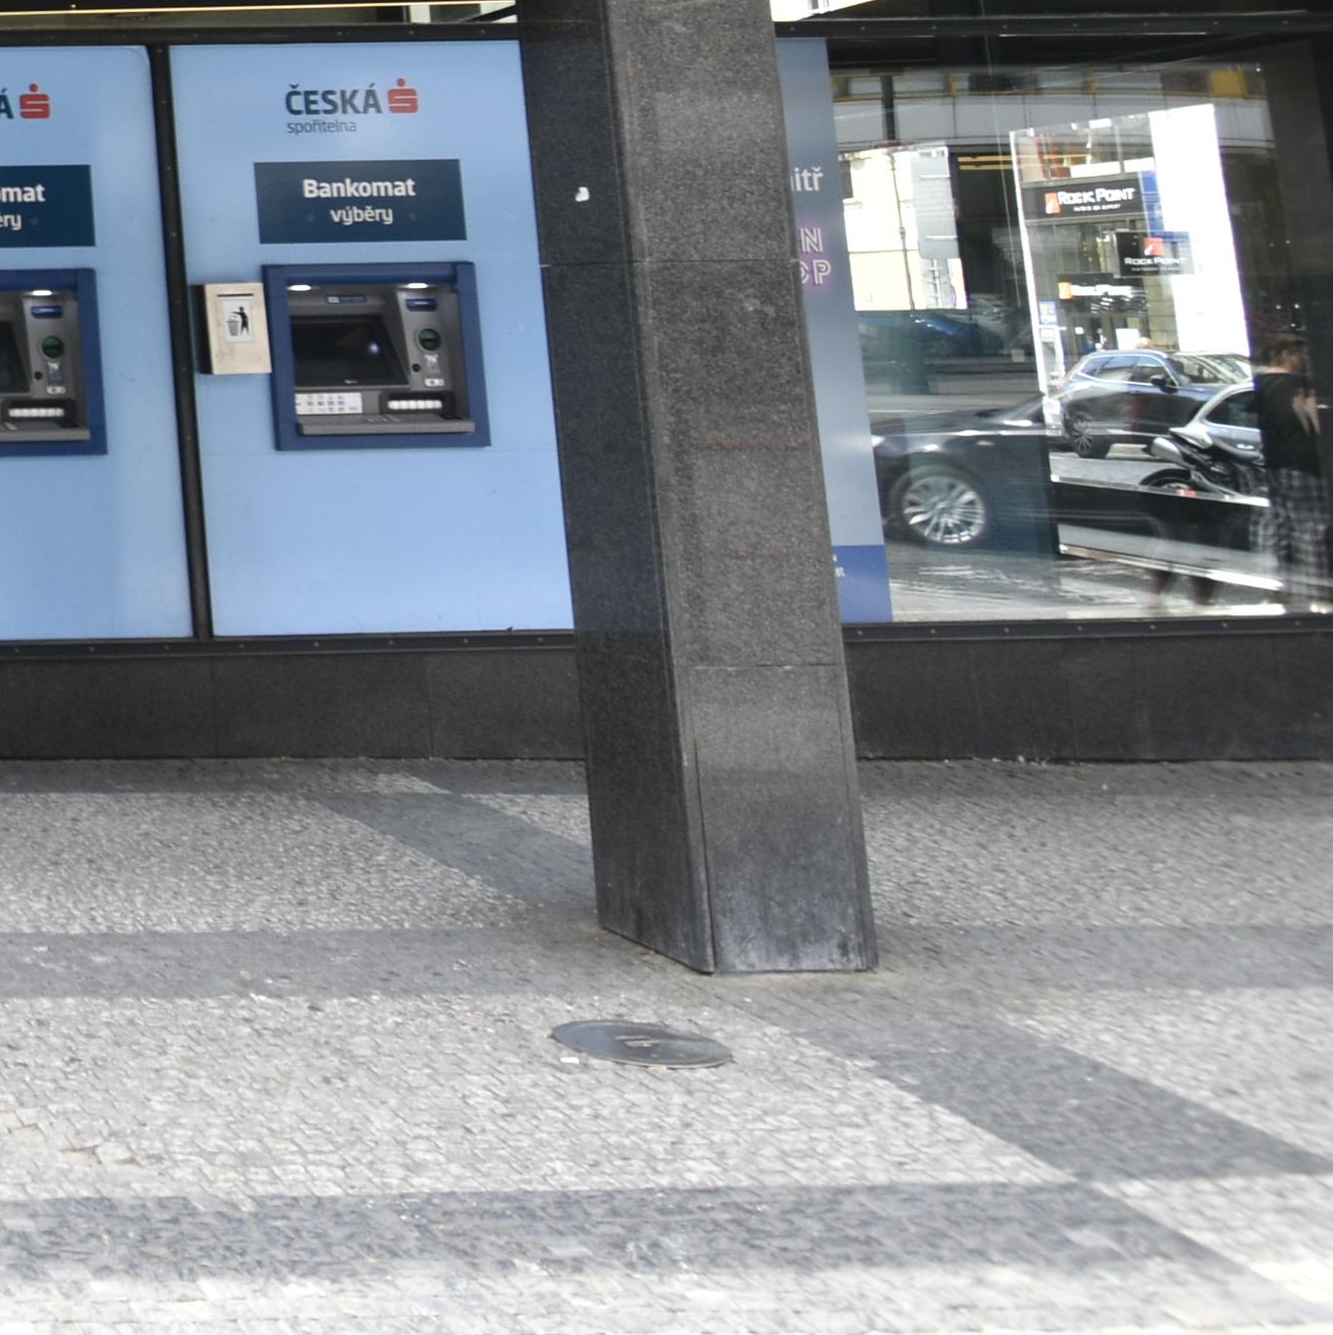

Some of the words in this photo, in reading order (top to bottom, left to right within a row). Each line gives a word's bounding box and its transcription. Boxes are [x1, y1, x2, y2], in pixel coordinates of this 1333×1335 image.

[285, 83, 382, 116] ČESKÁ
[287, 120, 357, 135] spořitelna
[303, 178, 416, 198] Bankomat
[790, 166, 824, 192] itř
[1058, 191, 1095, 205] ROCK
[1096, 188, 1135, 202] POINT
[330, 206, 393, 226] výběry
[1124, 257, 1153, 265] ROCK
